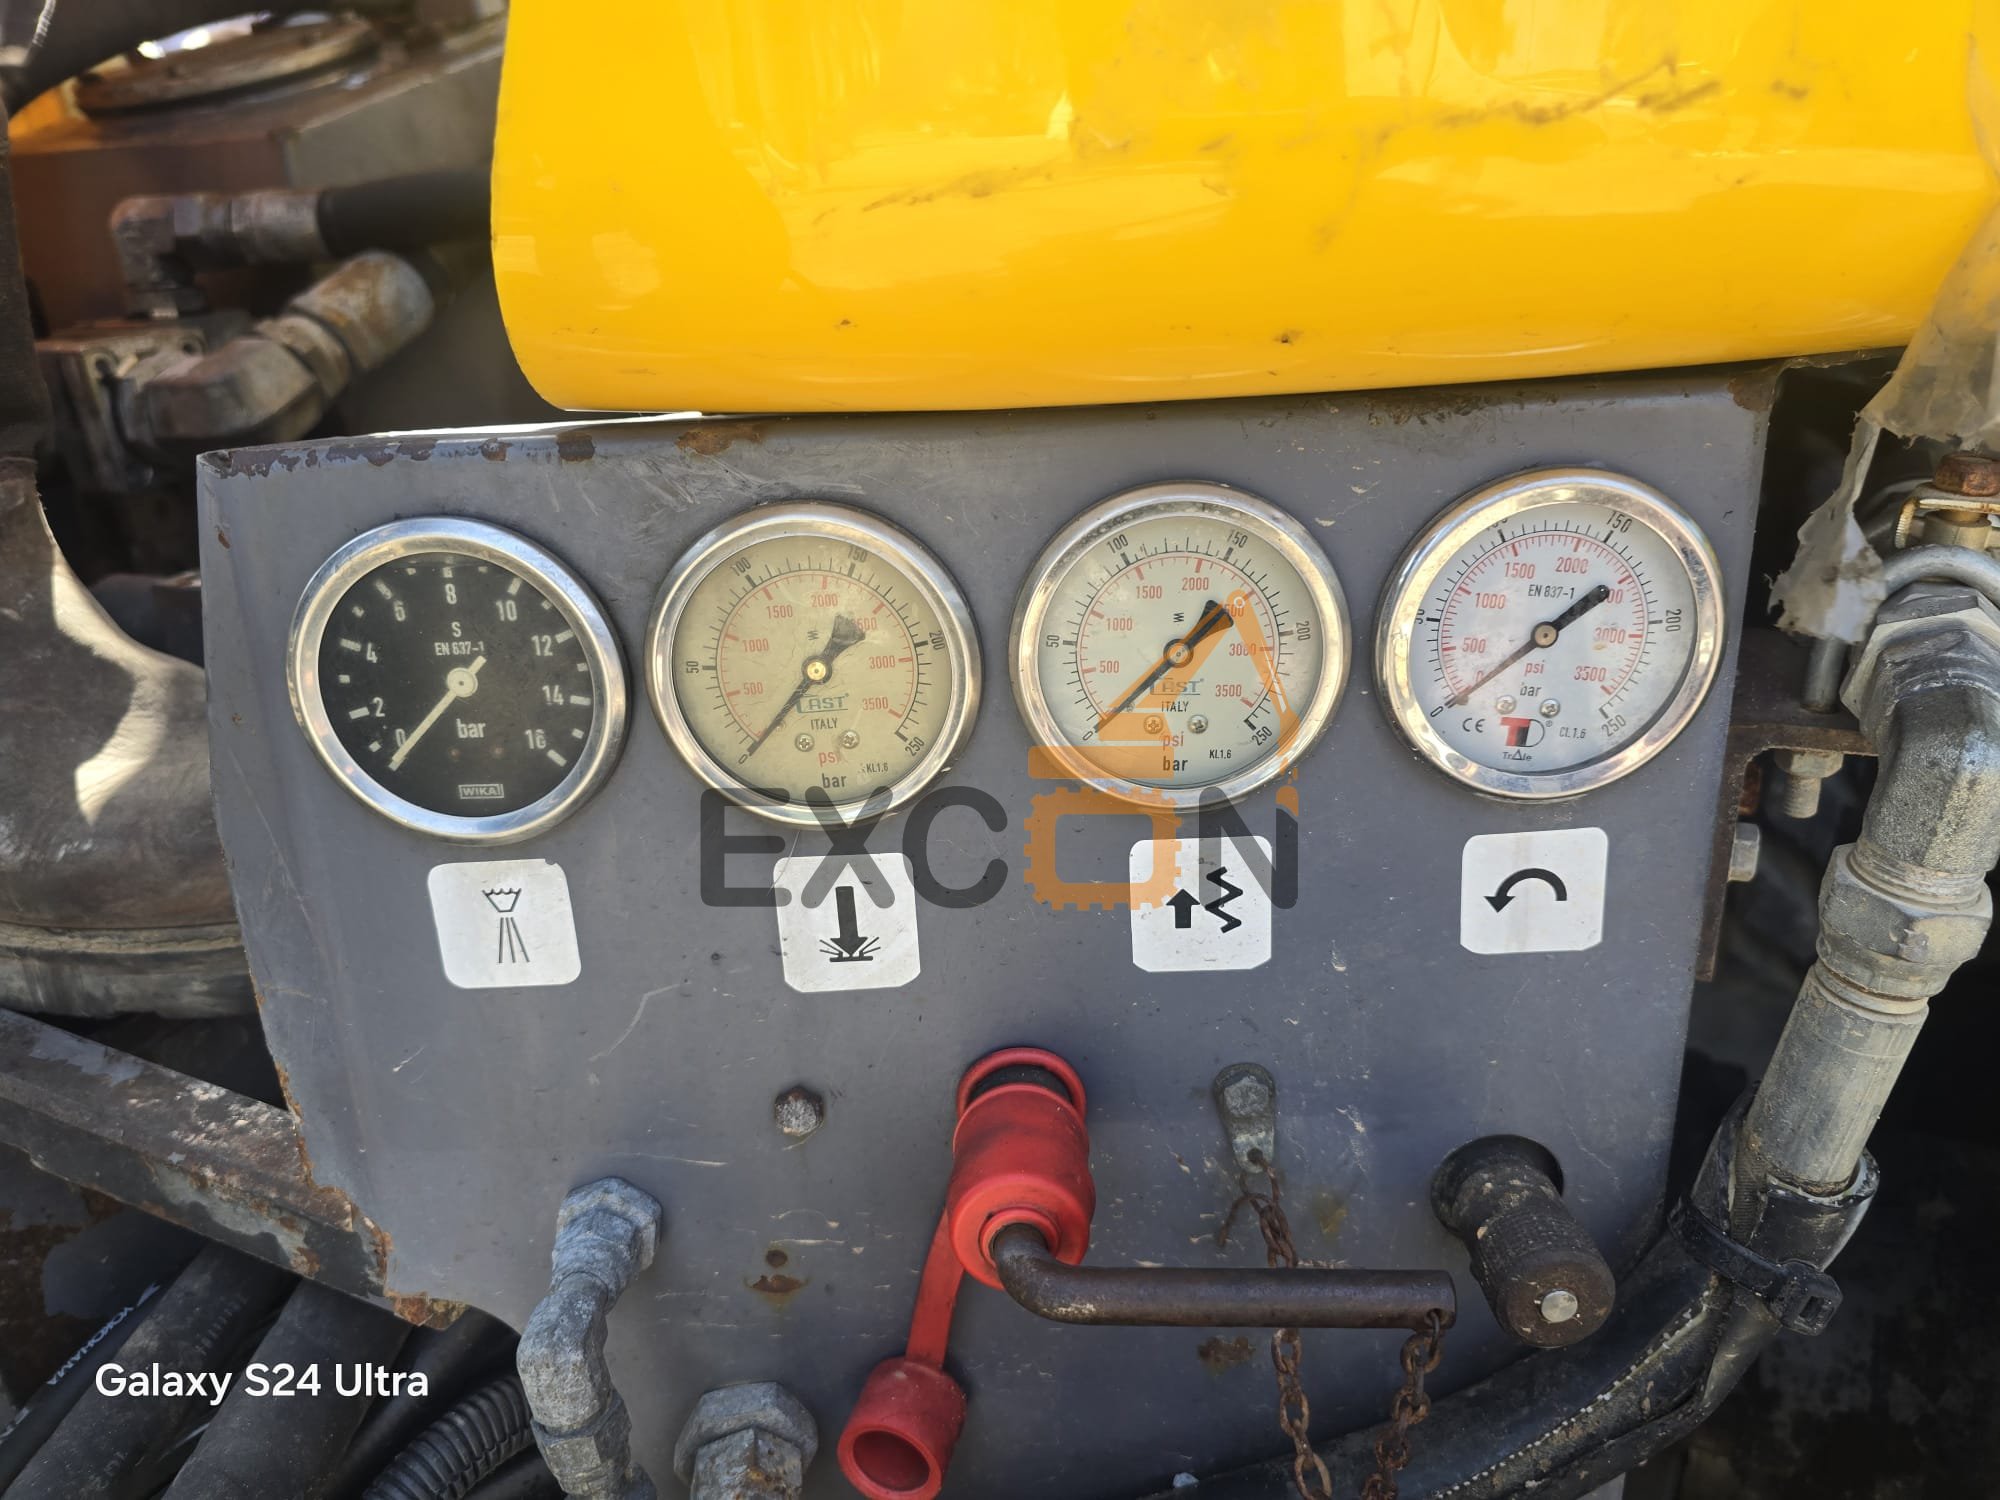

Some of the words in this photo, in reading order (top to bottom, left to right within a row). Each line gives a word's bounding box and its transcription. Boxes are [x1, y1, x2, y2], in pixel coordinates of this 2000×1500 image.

[1607, 511, 1632, 533] 150
[1107, 534, 1129, 554] 100
[1227, 529, 1249, 548] 150
[731, 556, 752, 577] 100
[1504, 562, 1535, 579] 1500
[1556, 557, 1589, 574] 2000
[1182, 577, 1209, 591] 2000
[1528, 584, 1542, 597] EN
[1544, 586, 1575, 599] 837-1
[445, 583, 457, 604] 8
[1136, 586, 1162, 599] 1500
[811, 593, 838, 608] 2000
[1475, 592, 1507, 609] 1000
[496, 599, 518, 621] 10
[766, 605, 793, 620] 1500
[1106, 618, 1133, 632] 1000
[1666, 609, 1681, 632] 200
[451, 621, 462, 637] S
[1297, 620, 1311, 641] 200
[434, 641, 450, 655] EN
[531, 635, 553, 656] 12
[742, 639, 769, 652] 1000
[929, 630, 945, 651] 200
[1046, 635, 1060, 648] 50
[1462, 637, 1486, 653] 500
[366, 643, 378, 664] 4
[1229, 643, 1257, 656] 3000
[686, 660, 699, 674] 50
[869, 655, 896, 669] 3000
[1100, 660, 1120, 674] 500
[1524, 660, 1545, 676] psi
[1574, 666, 1607, 681] 3500
[542, 684, 564, 705] 14
[743, 682, 764, 695] 500
[1215, 684, 1242, 697] 3500
[1520, 682, 1541, 696] bar
[372, 696, 386, 717] 2
[862, 697, 889, 710] 3500
[1161, 700, 1189, 712] ITALY
[1430, 705, 1443, 717] 0
[456, 718, 486, 739] bar
[810, 718, 838, 730] ITALY
[1601, 714, 1626, 737] 250
[525, 728, 546, 749] 16
[1082, 730, 1094, 741] 0
[1162, 731, 1184, 751] psi
[1251, 726, 1273, 746] 250
[904, 736, 925, 756] 250
[738, 753, 748, 764] 0
[1162, 756, 1188, 771] bar
[821, 773, 847, 788] bar
[461, 785, 500, 797] WIKA
